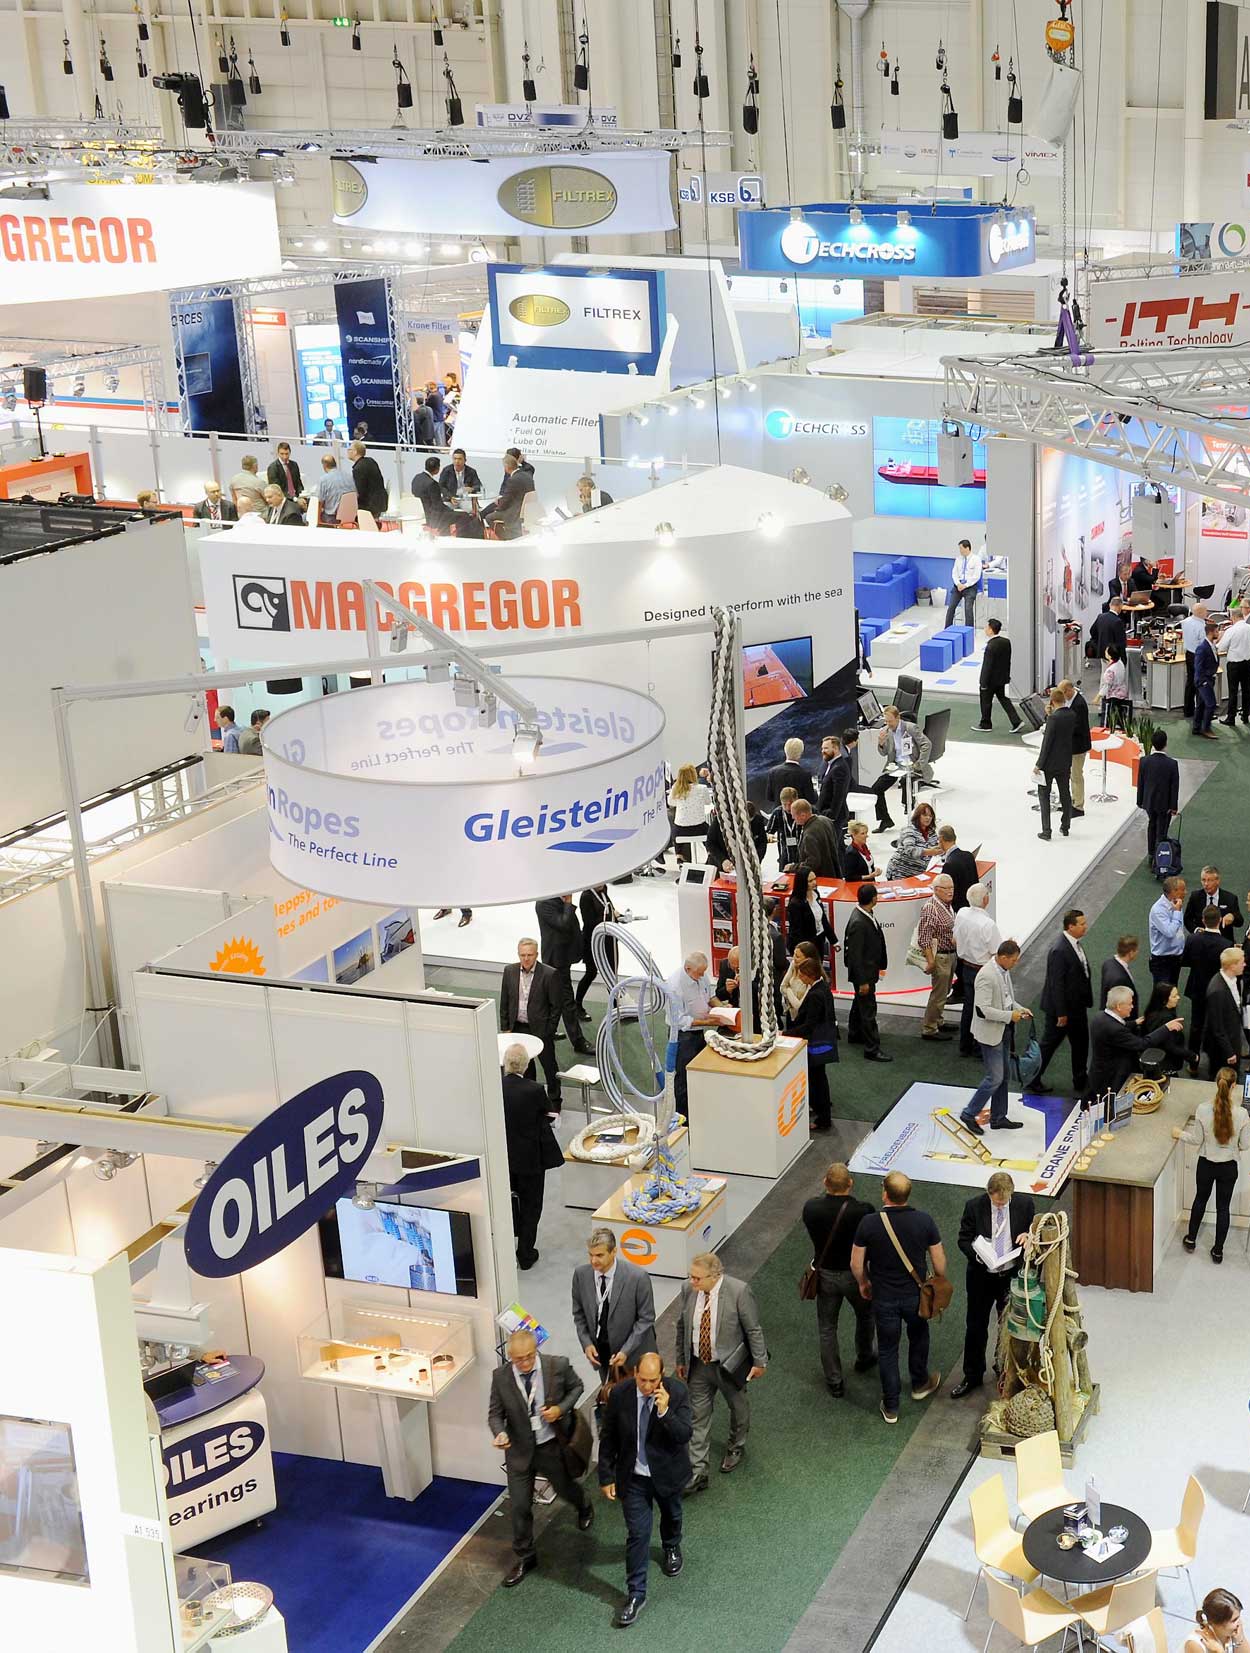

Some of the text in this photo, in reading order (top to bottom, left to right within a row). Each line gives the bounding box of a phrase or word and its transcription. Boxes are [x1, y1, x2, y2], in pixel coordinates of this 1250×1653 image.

[552, 190, 615, 203] FILTREX
[710, 192, 736, 203] KSB
[583, 307, 643, 322] FILTREX
[512, 412, 600, 428] Automatic Filter
[514, 427, 547, 437] Fuel Oil
[512, 437, 548, 447] Lube Oil
[290, 579, 582, 631] MACGREGOR
[644, 605, 706, 622] Designed
[776, 593, 801, 607] with
[803, 591, 821, 602] the
[824, 587, 843, 599] sea
[278, 785, 361, 839] Ropes
[463, 786, 629, 843] Gleistein
[288, 831, 399, 869] The Perfect Line
[298, 905, 320, 927] and
[208, 1087, 370, 1261] OILES
[1040, 1144, 1071, 1179] CRANE
[169, 1478, 258, 1527] earings
